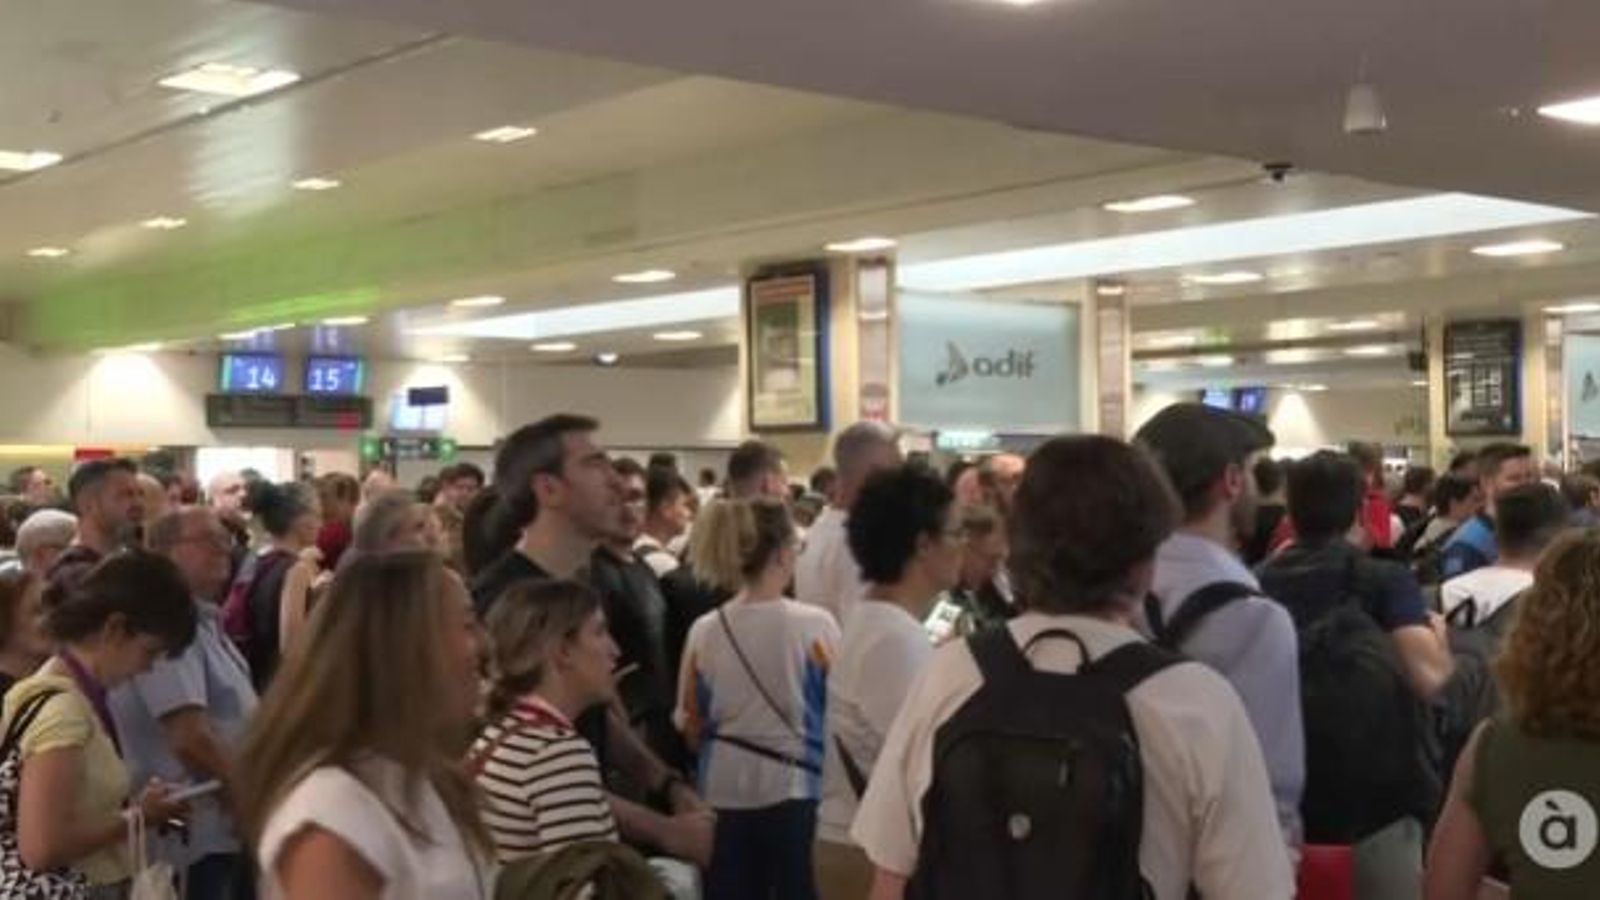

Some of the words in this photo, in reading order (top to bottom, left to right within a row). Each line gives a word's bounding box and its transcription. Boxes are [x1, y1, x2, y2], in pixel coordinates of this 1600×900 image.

[972, 350, 1035, 379] adif
[247, 366, 277, 388] 14
[311, 368, 341, 391] 15
